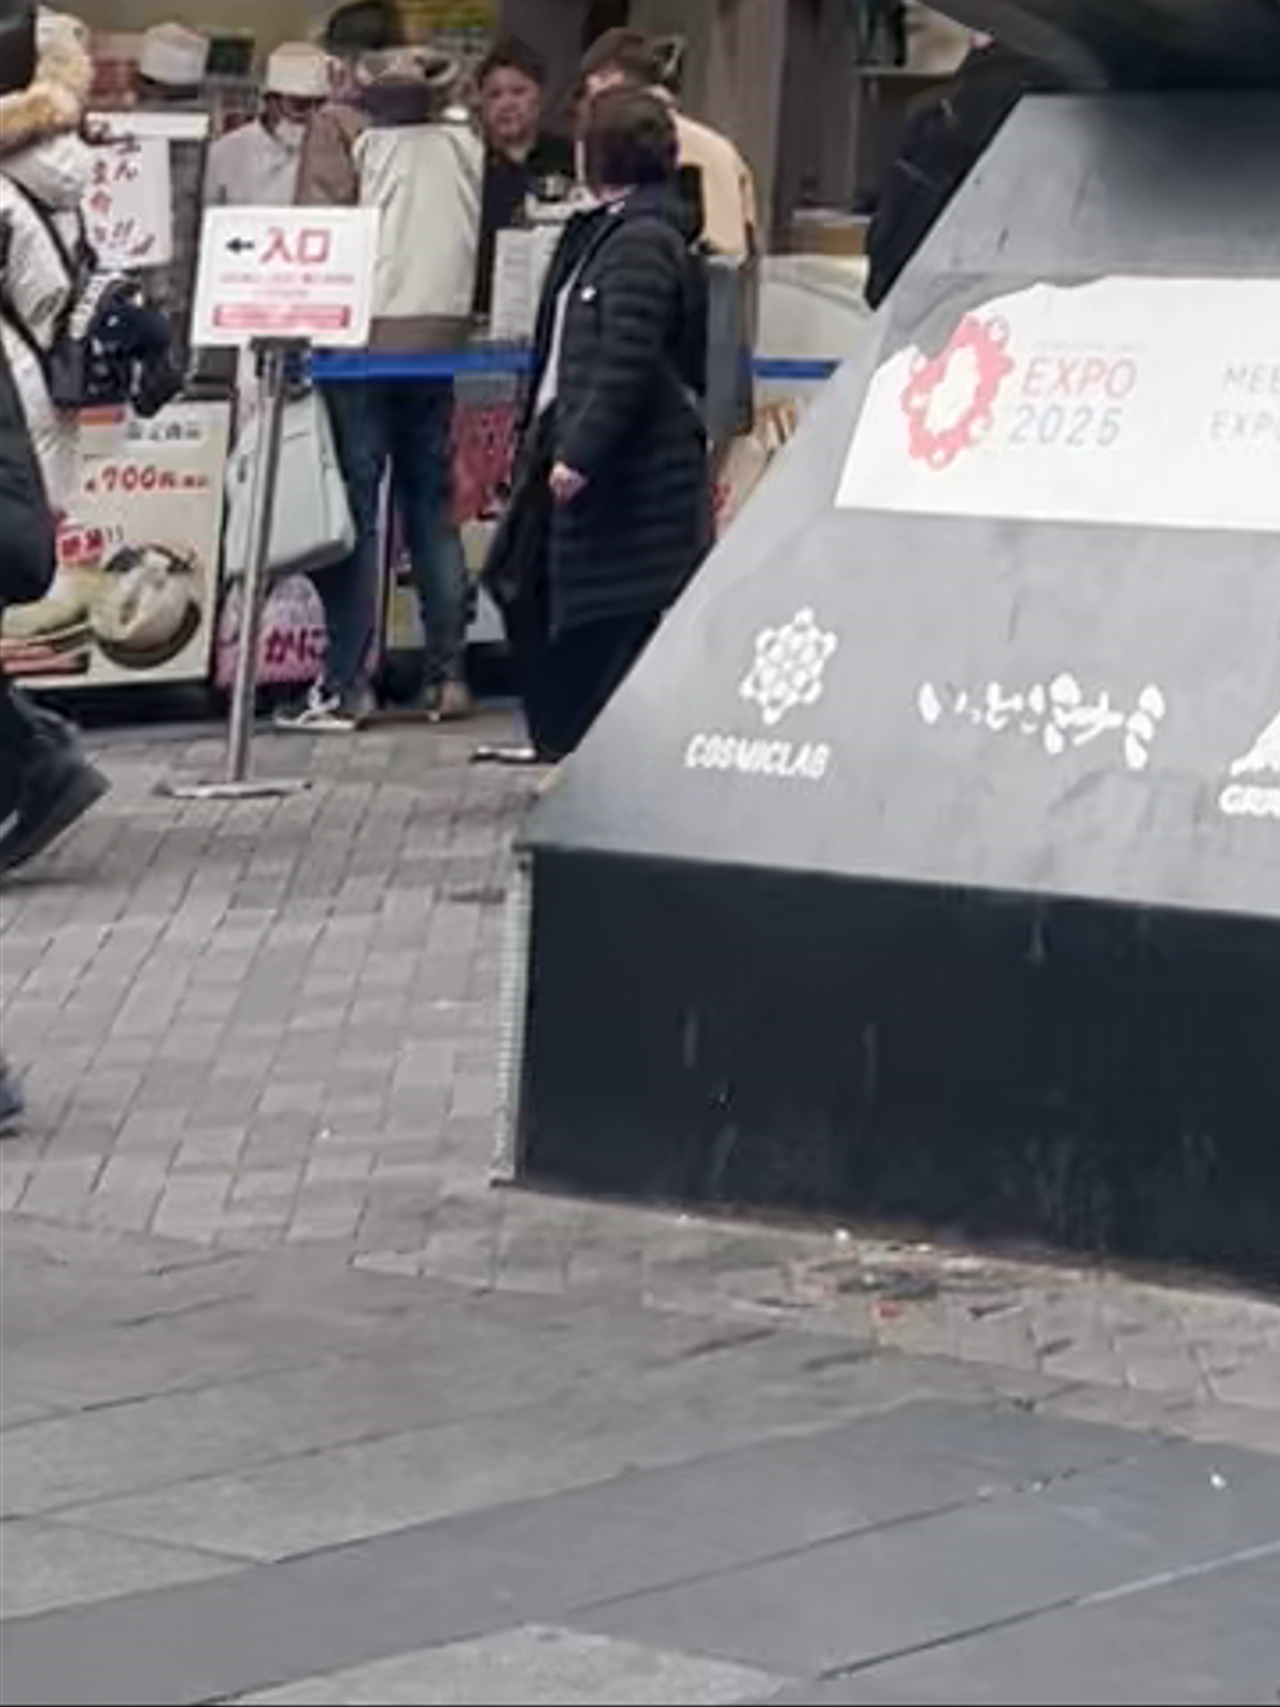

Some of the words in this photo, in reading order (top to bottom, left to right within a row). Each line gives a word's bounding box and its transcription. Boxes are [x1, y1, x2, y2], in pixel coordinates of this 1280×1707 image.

[260, 227, 331, 264] 入口
[1019, 358, 1138, 400] EXPO
[1007, 404, 1124, 448] 2025
[684, 733, 831, 780] COSMICLAB
